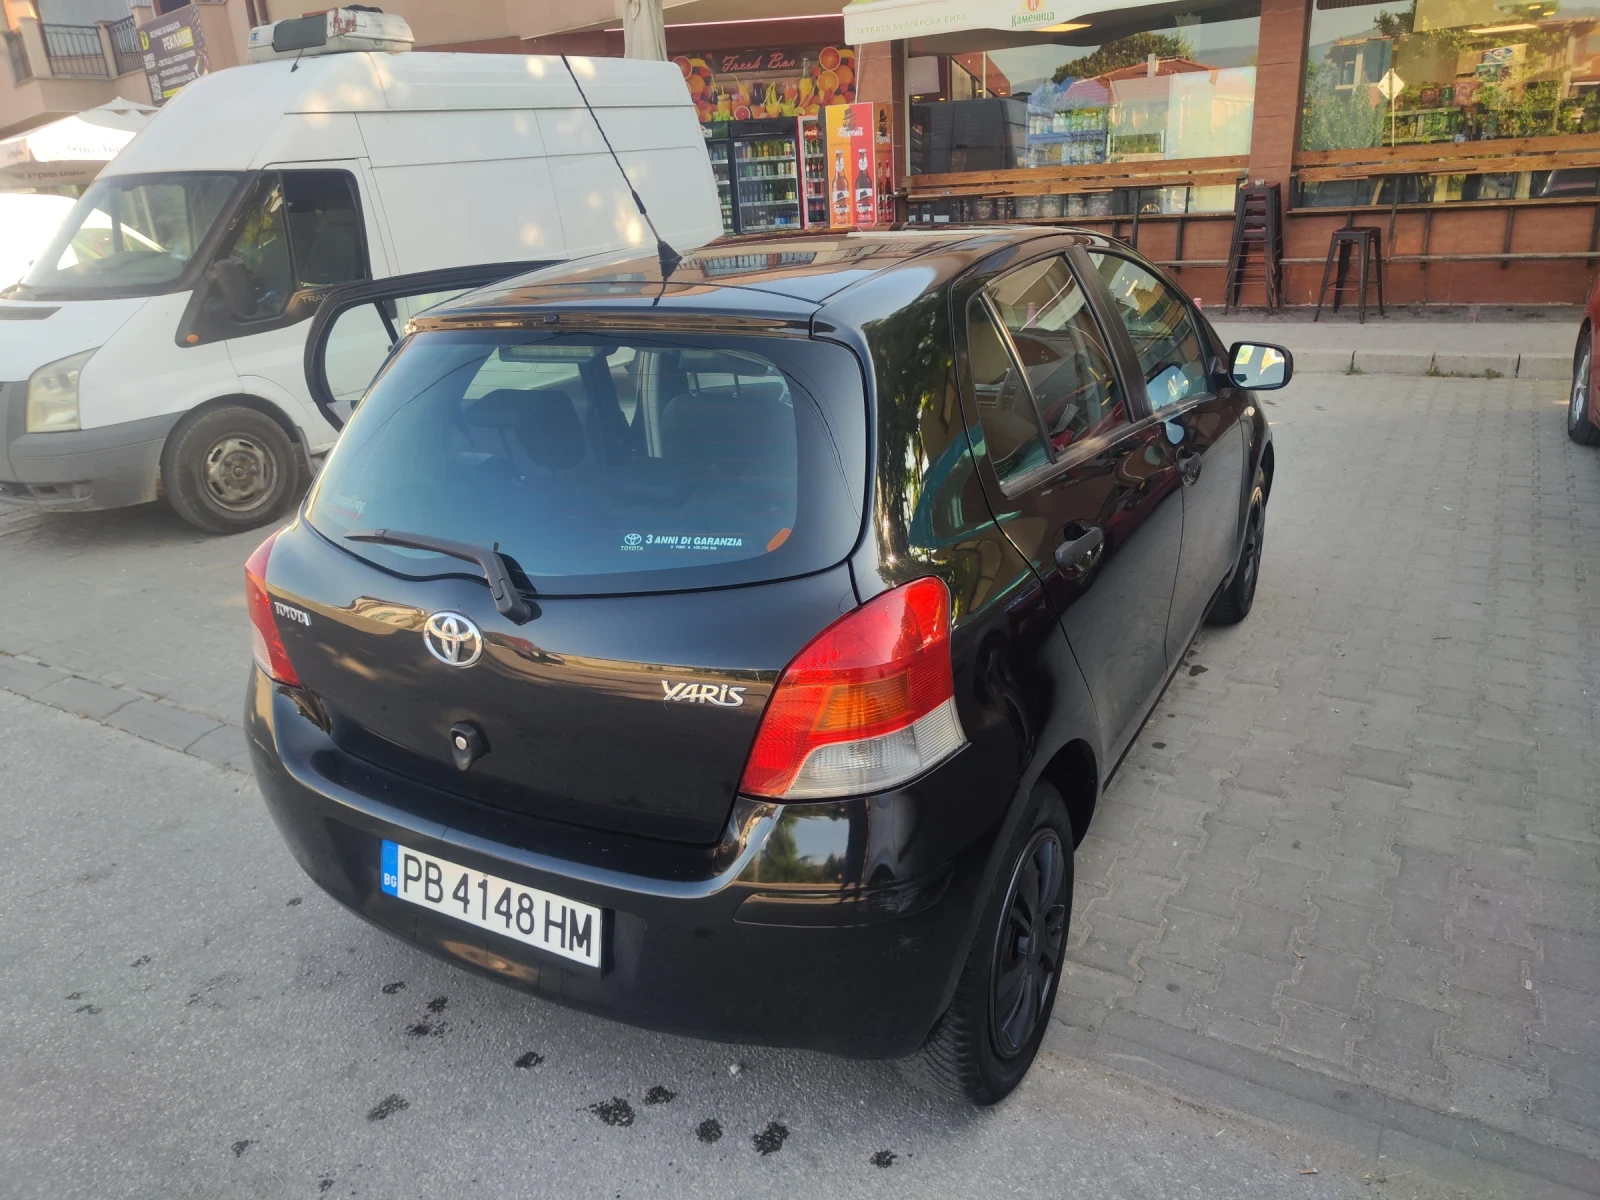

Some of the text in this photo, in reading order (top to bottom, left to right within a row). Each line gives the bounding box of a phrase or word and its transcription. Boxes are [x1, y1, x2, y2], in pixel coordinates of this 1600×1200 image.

[854, 14, 967, 36] ПЪРВАТА БЪЛГАРСКА БИРА
[1011, 11, 1055, 28] Каменица
[722, 52, 796, 72] Fresh Bar
[645, 534, 742, 546] 3 ANNI DI GARANZIA
[274, 601, 311, 626] TOYOTA
[383, 872, 398, 888] BG
[403, 853, 593, 958] PB 4148 HM
